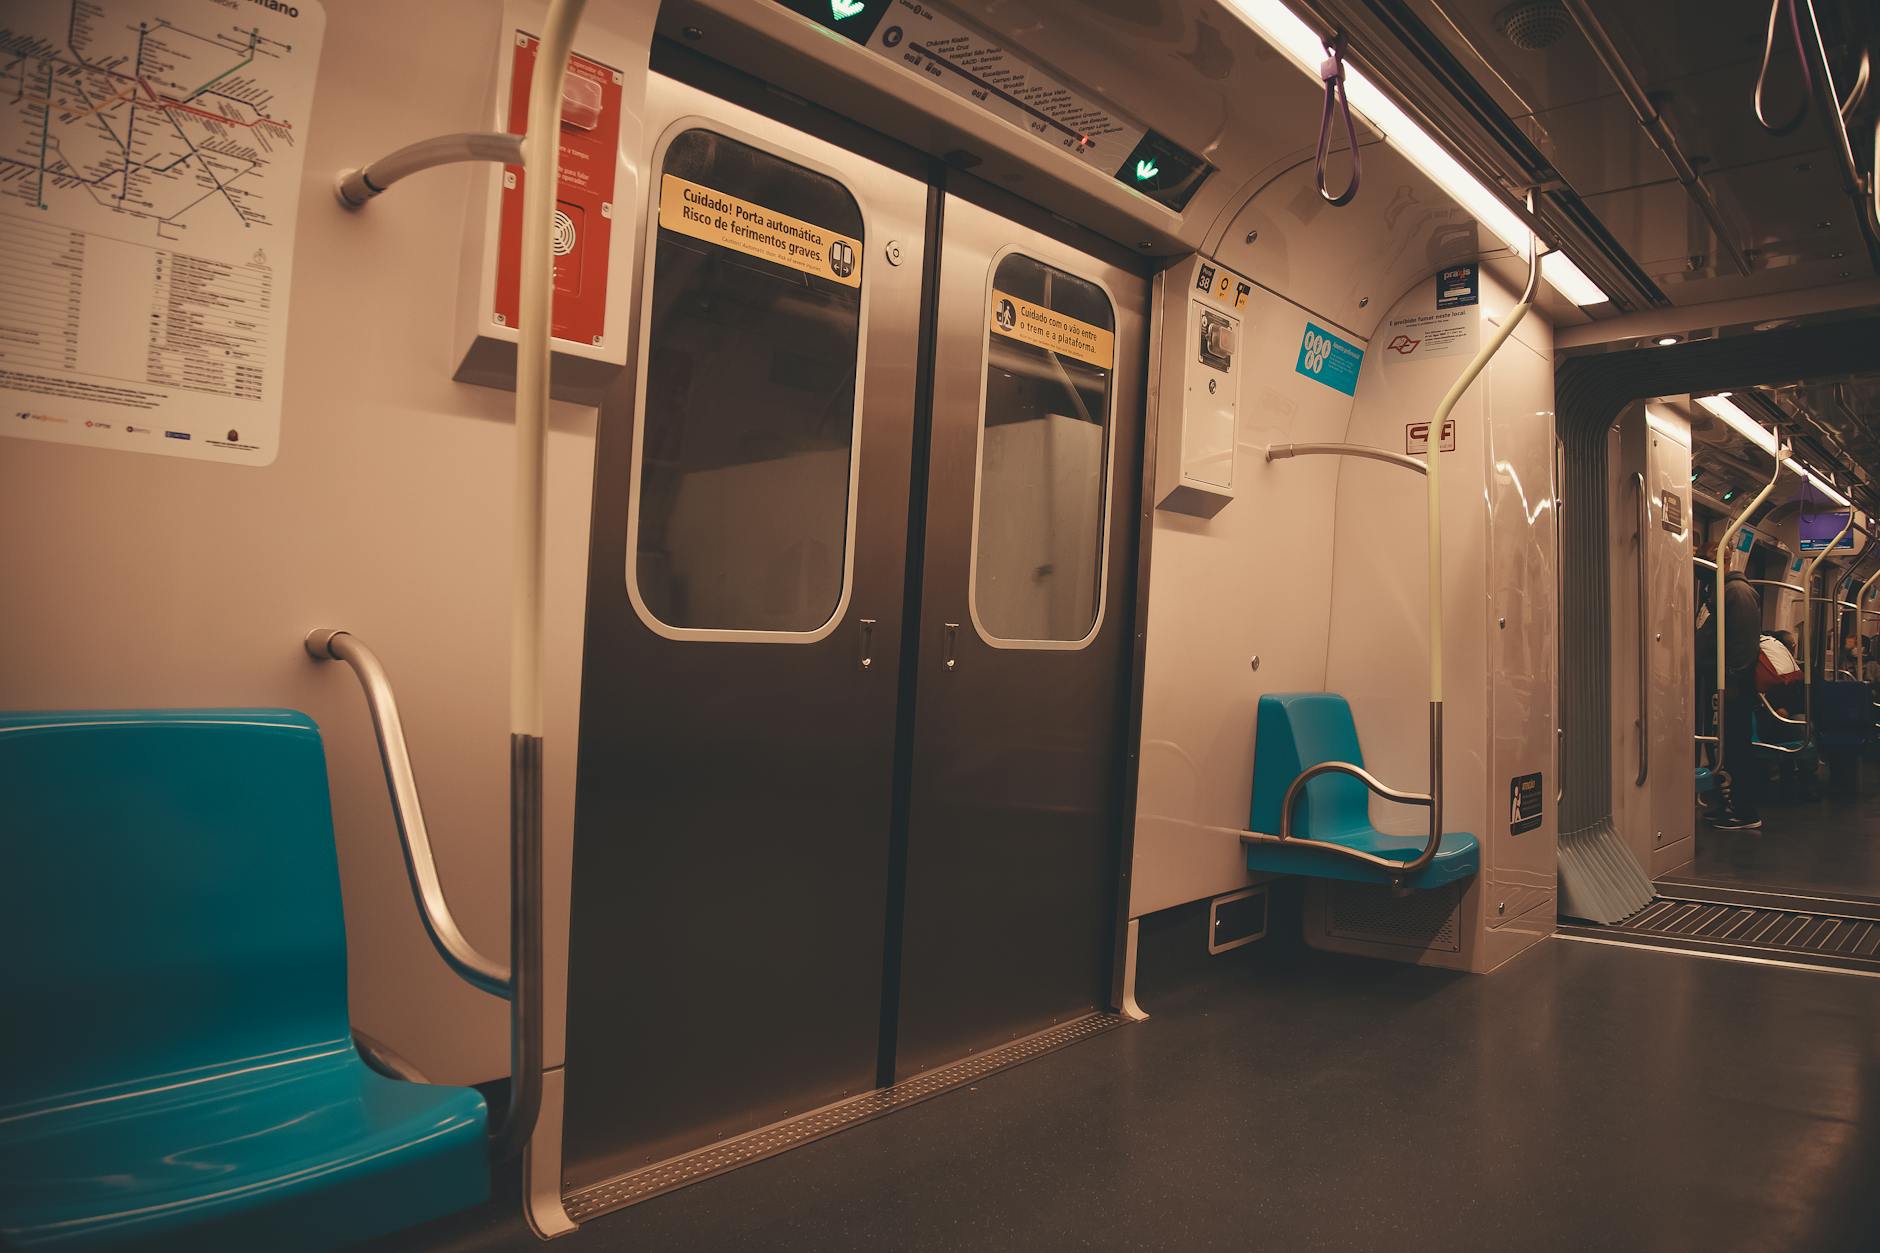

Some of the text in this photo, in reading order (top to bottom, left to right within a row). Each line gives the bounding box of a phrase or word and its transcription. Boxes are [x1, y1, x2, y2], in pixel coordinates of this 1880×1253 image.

[682, 205, 823, 262] Risco de ferimentos graves.
[683, 188, 824, 246] Cuidado! Porta automática.
[1199, 275, 1210, 289] 38
[1020, 306, 1048, 324] Cuidado
[1048, 317, 1063, 329] com
[1069, 323, 1081, 335] vão
[1081, 329, 1098, 342] entre
[1020, 321, 1097, 354] o trem e a plataforma.
